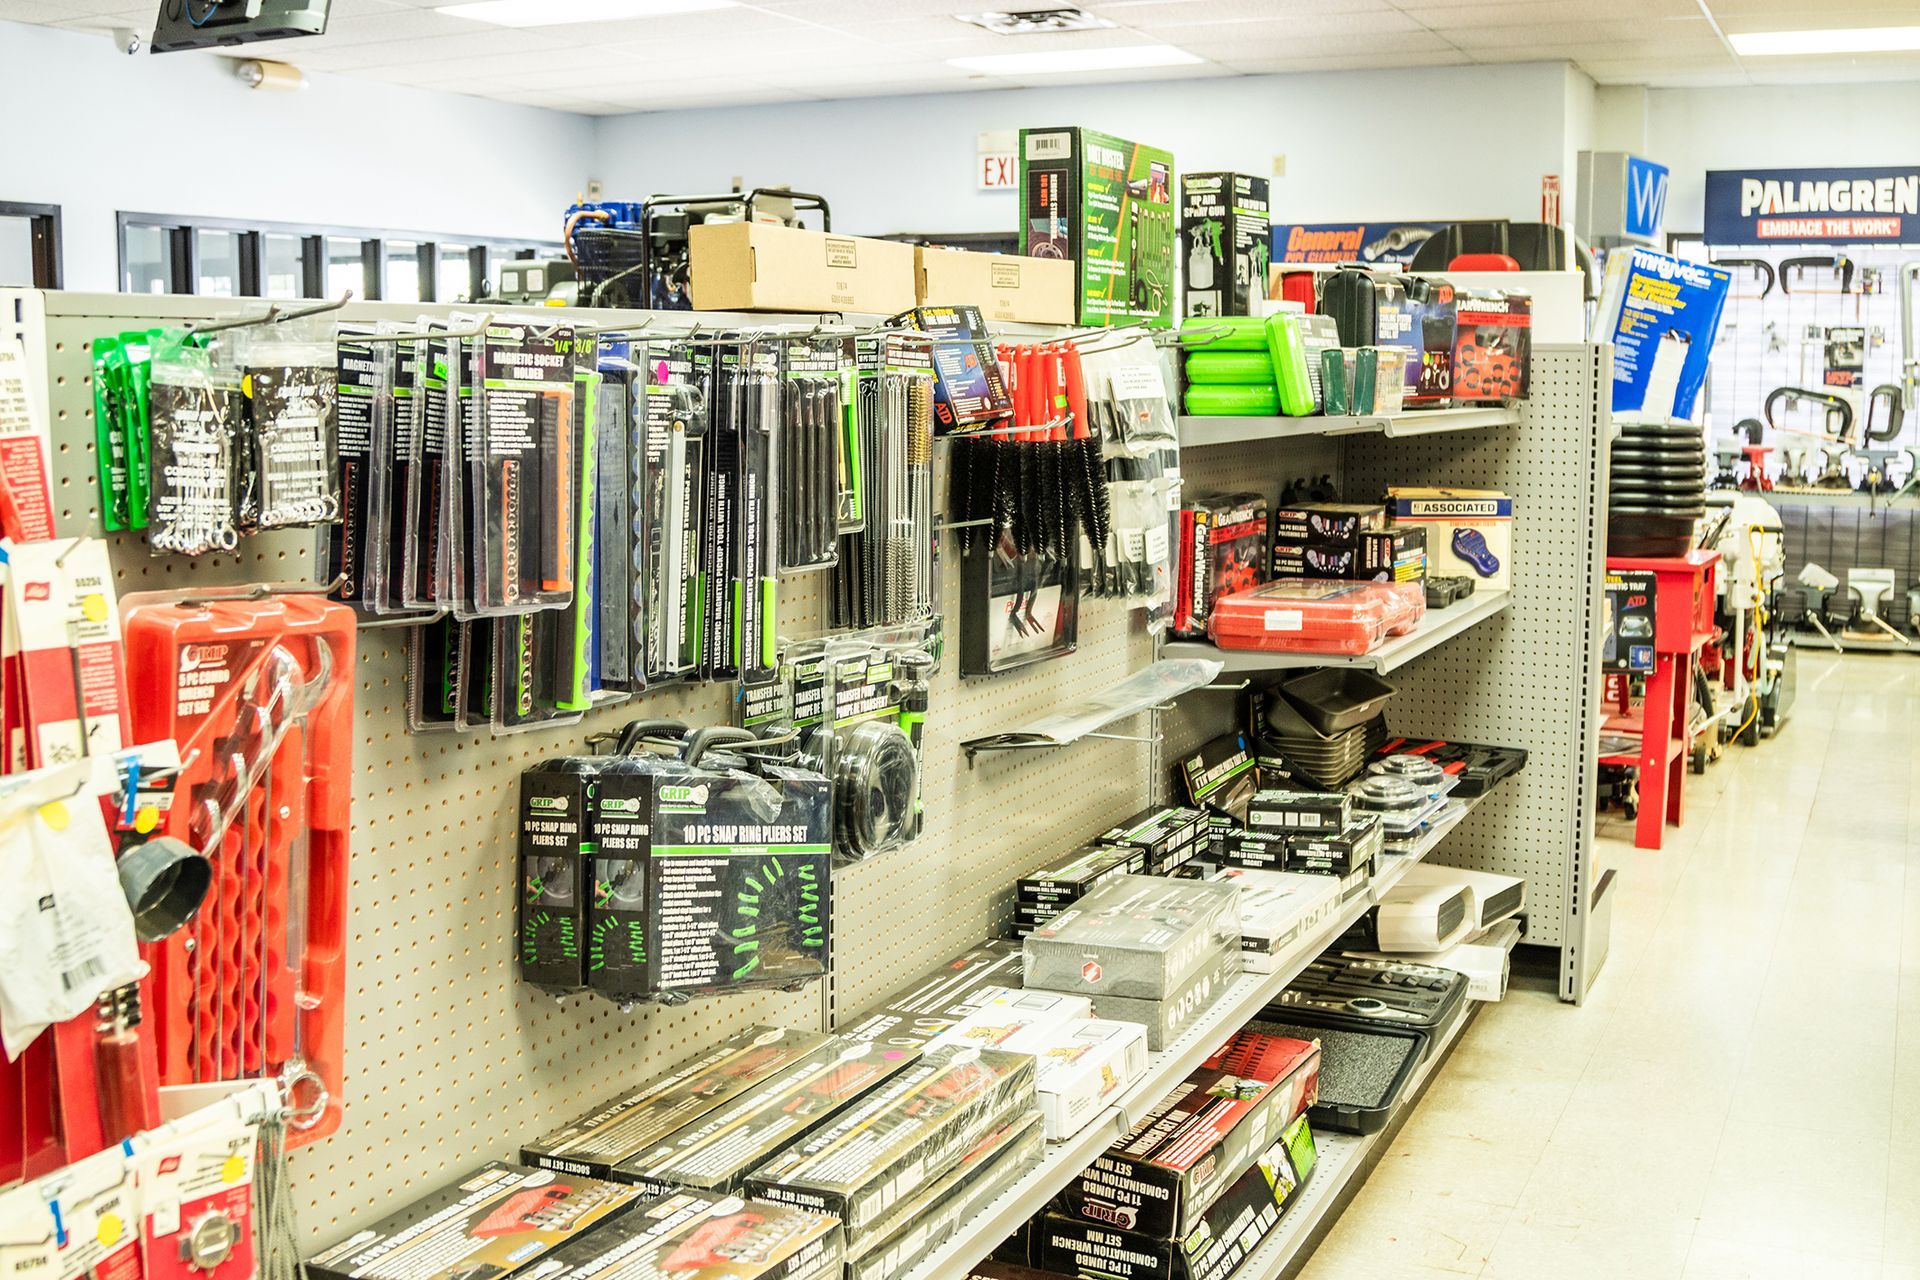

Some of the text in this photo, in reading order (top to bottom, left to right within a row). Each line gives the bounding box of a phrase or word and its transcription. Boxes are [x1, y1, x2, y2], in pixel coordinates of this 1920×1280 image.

[1202, 194, 1217, 205] AIR
[1741, 175, 1918, 217] PALMGREN
[1208, 205, 1226, 217] GUN
[1761, 219, 1851, 236] EMBRACE THE
[1286, 225, 1366, 252] General
[554, 340, 573, 353] 1/4"
[575, 339, 596, 353] 3/8"
[493, 351, 565, 368] MAGNETIC SOCKET
[513, 367, 544, 380] HOLDER
[935, 402, 953, 425] ATD
[683, 480, 691, 529] PORTABLE
[1423, 503, 1495, 513] ASSOCIATED
[713, 472, 726, 670] TELESCOPIC MAGNETIC PICKUP TOOL WITH HINGE
[743, 472, 756, 671] TELESCOPIC MAGNETIC PICKUP TOOL WITH HINGE
[1194, 523, 1207, 614] GEARWRENCH
[1627, 595, 1647, 608] ATD
[179, 668, 230, 687] 5 PC COMBO
[178, 684, 216, 702] WRENCH
[746, 686, 773, 703] TRANSFER
[795, 688, 821, 705] TRANSFER
[836, 684, 876, 705] TRANSFER PUMP
[177, 699, 211, 717] SET SAE
[746, 700, 773, 718] POMPE DE
[794, 702, 821, 720] POMPE DE
[836, 702, 854, 720] POMPE
[853, 702, 860, 714] DE
[524, 821, 578, 834] 10 PC SNAP RING
[594, 823, 649, 836] 10 PC SNAP RING
[683, 824, 808, 844] 10 PC SNAP RING PLIERS SET
[532, 834, 568, 847] PLIERS SET
[601, 838, 640, 850] PLIERS SET
[552, 1160, 590, 1175] SOCKET SET
[1095, 1157, 1133, 1177] SET MM
[1193, 1154, 1217, 1186] GRIP
[1082, 1180, 1142, 1206] 11 PC JUMBO
[1101, 1170, 1169, 1200] COMBINATION
[766, 1188, 825, 1208] SOCKET SET SAE
[1081, 1203, 1133, 1229] GRIP
[1086, 1229, 1123, 1247] SET MM
[1185, 1229, 1202, 1253] GRIP
[1052, 1235, 1158, 1269] COMBINATION WRENCH
[1075, 1253, 1133, 1276] 11 PC JUMBO
